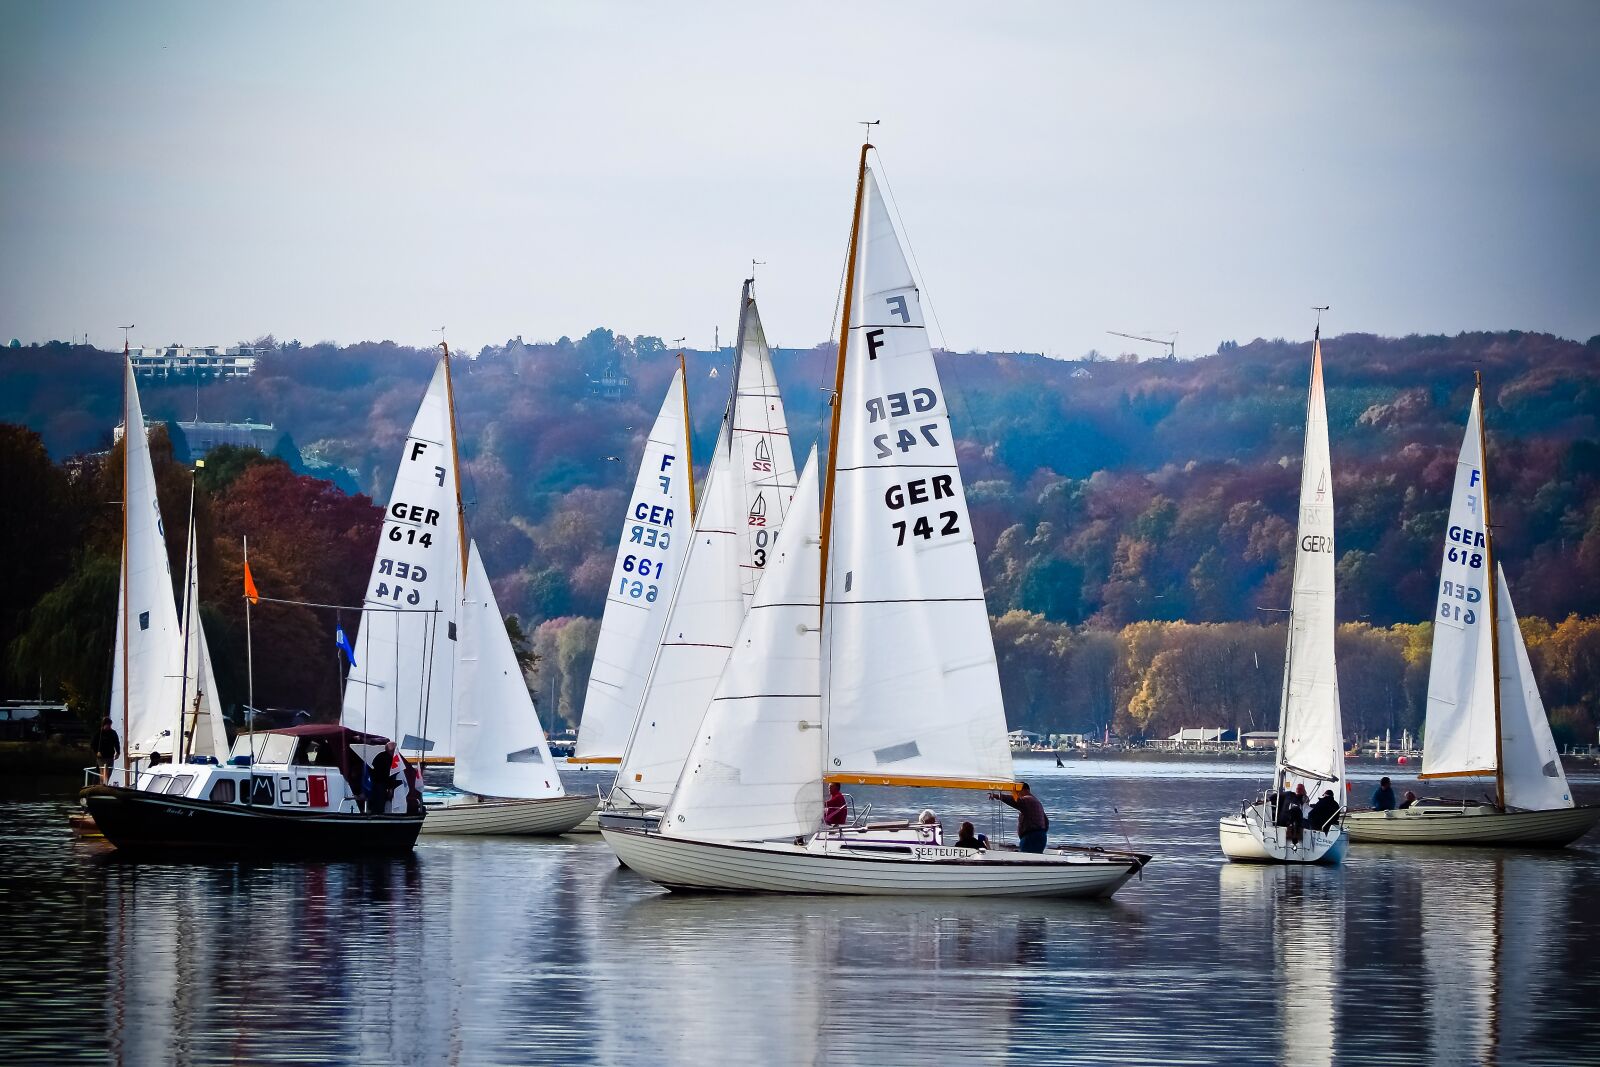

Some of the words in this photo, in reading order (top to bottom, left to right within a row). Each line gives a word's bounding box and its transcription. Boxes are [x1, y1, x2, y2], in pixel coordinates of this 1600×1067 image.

[866, 329, 884, 361] F
[410, 442, 427, 461] F
[660, 454, 675, 472] F
[1470, 469, 1480, 487] F
[885, 474, 955, 510] GER
[391, 502, 440, 526] GER
[635, 502, 674, 528] GER
[748, 516, 767, 527] 22
[389, 526, 432, 548] 614
[892, 510, 960, 547] 742
[1449, 526, 1485, 549] GER
[1301, 535, 1325, 552] GER
[622, 554, 663, 580] 661
[1447, 547, 1482, 569] 618
[253, 778, 272, 797] M
[915, 847, 970, 858] SEETEUFEL
